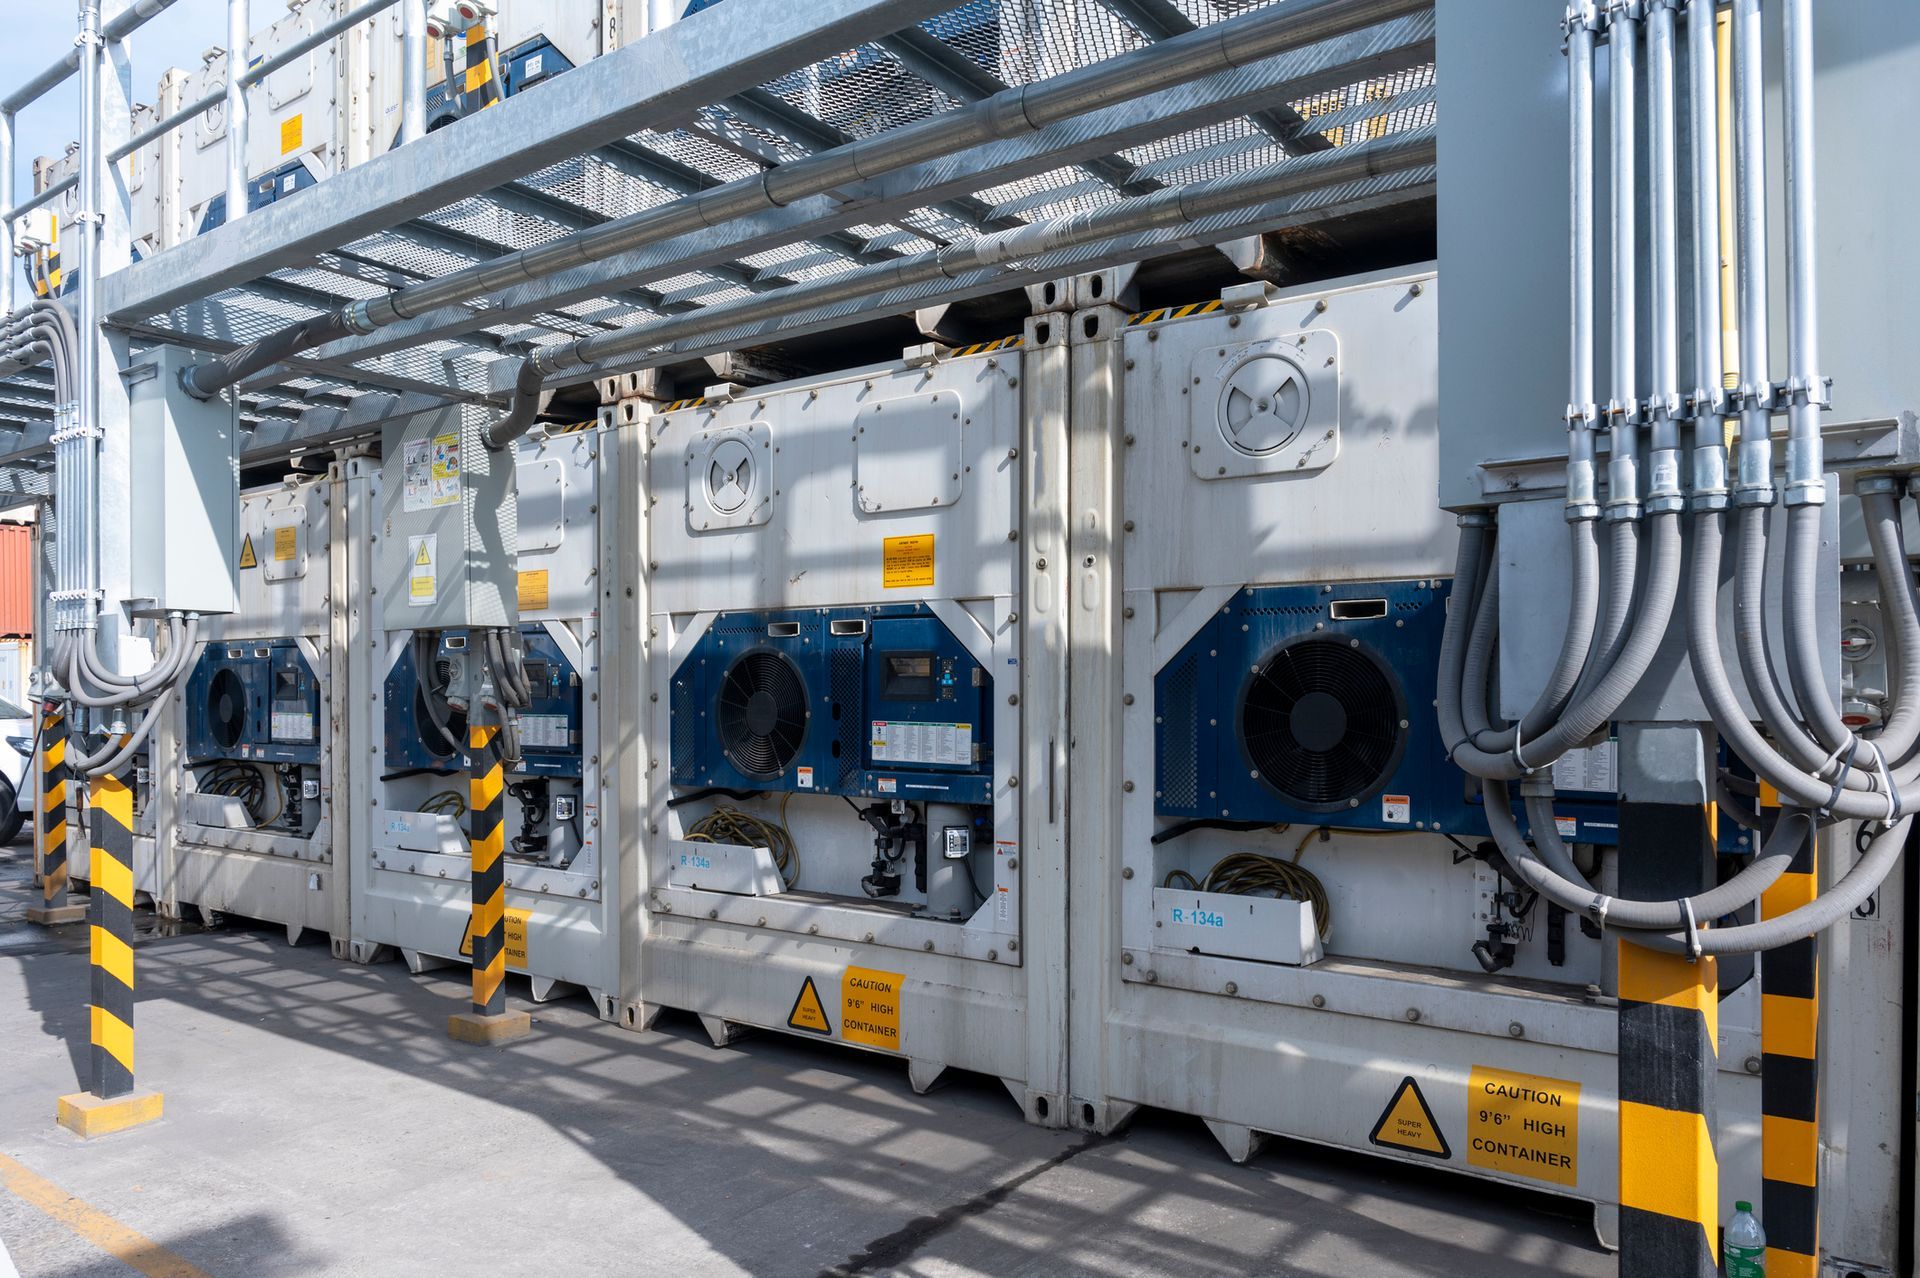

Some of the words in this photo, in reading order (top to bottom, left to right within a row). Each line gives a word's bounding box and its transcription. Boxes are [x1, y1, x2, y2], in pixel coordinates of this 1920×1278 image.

[504, 916, 522, 925] UTION
[1173, 908, 1223, 927] R-134a
[508, 932, 522, 941] HIGH
[504, 947, 526, 959] TAINER
[849, 977, 892, 993] CAUTION
[802, 1006, 816, 1014] SUPER
[870, 1002, 894, 1015] HIGH
[843, 1018, 897, 1038] CONTAINER
[1484, 1082, 1562, 1107] CAUTION
[1397, 1118, 1422, 1129] SUPER
[1523, 1118, 1566, 1138] HIGH
[1397, 1129, 1422, 1139] HEAVY
[1472, 1138, 1572, 1169] CONTAINER
